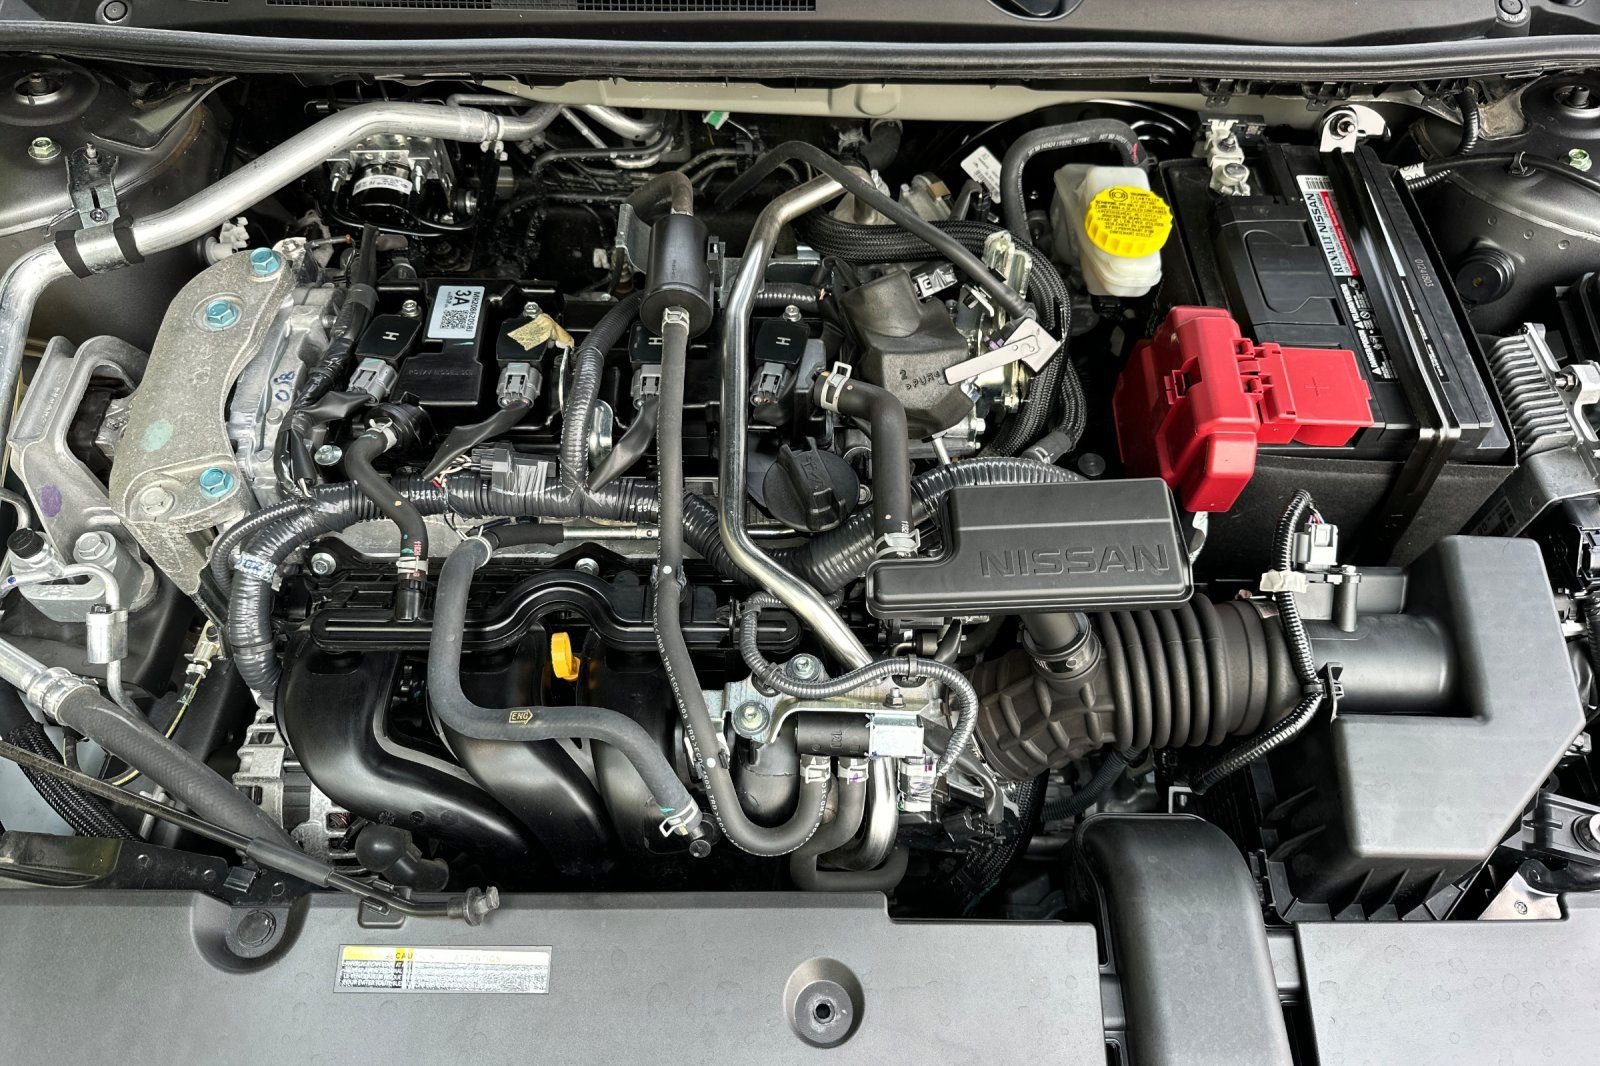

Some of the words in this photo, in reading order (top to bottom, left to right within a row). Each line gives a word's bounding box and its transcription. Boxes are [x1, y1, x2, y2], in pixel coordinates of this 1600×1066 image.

[1305, 193, 1329, 233] NISSAN
[452, 290, 472, 307] 3A
[382, 331, 400, 341] H
[776, 336, 791, 346] H
[979, 543, 1170, 578] NISSAN
[511, 711, 529, 721] ENG
